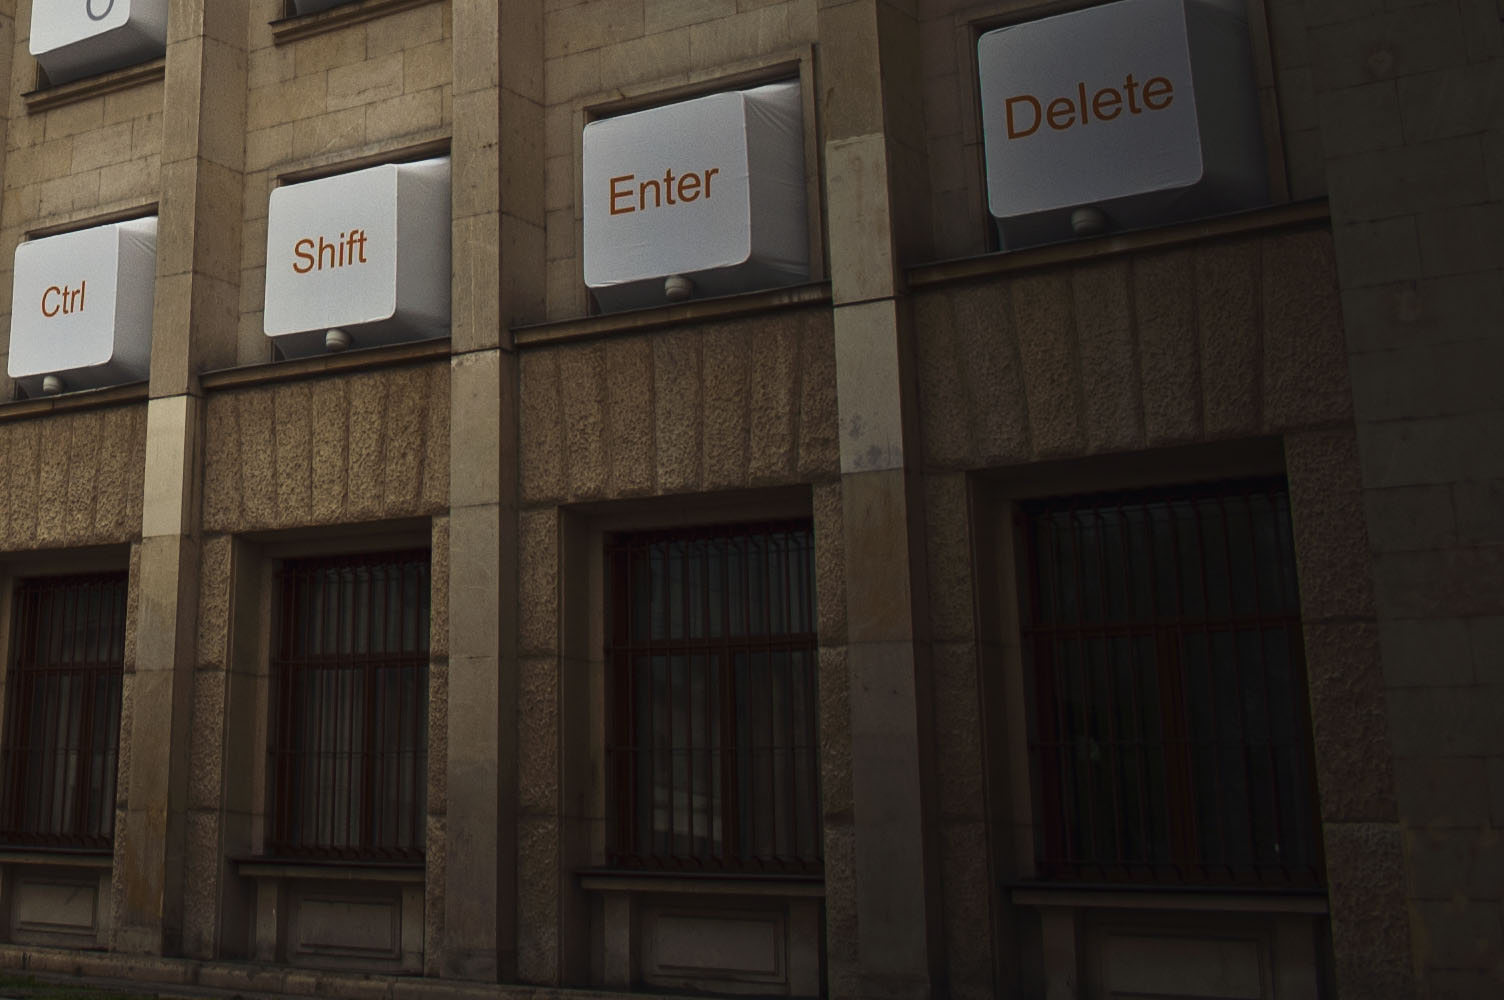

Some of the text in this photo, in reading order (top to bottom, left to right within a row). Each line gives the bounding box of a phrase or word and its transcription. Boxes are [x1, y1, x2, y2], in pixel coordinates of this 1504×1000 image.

[1004, 73, 1175, 140] Delete
[609, 167, 720, 216] Enter
[292, 228, 368, 274] Shift
[40, 280, 86, 318] Ctrl
